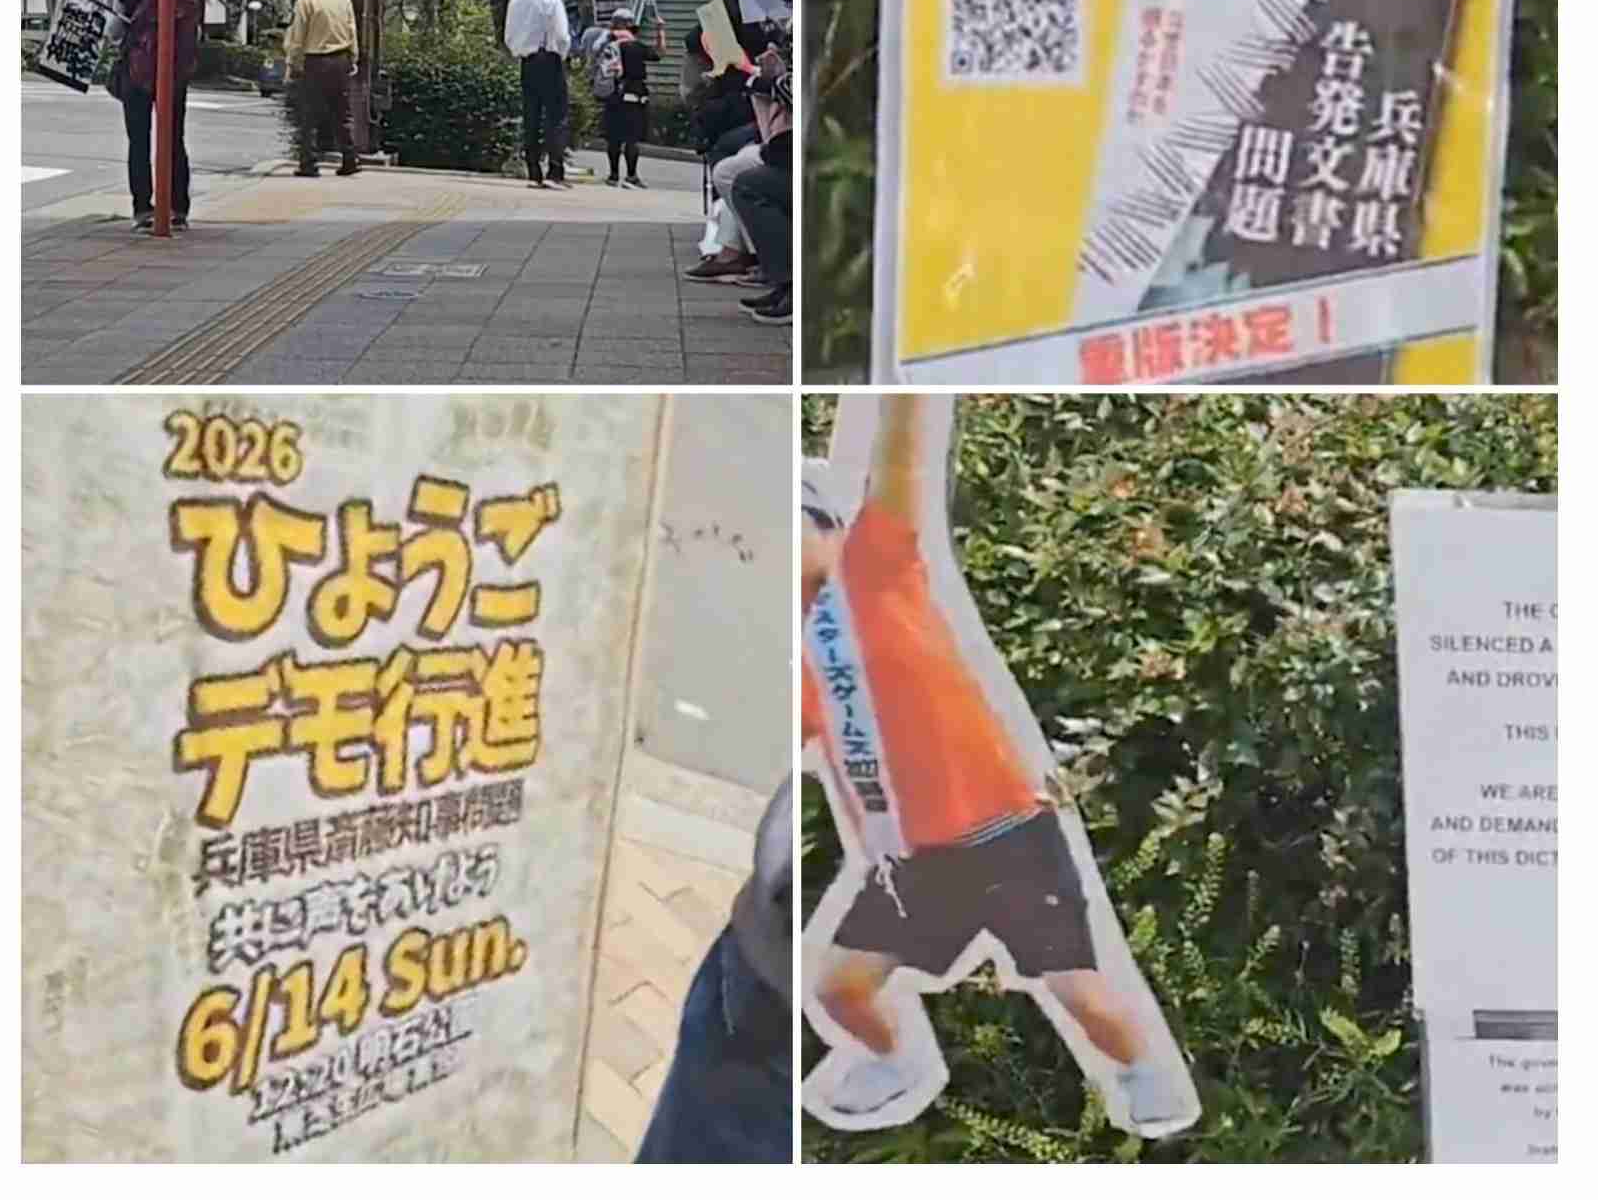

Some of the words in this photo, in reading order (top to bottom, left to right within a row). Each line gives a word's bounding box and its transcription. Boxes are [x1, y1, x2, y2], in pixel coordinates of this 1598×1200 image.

[1292, 20, 1375, 251] 告発文書
[1222, 123, 1294, 244] 問題
[163, 409, 303, 488] 2026
[168, 474, 561, 650] ひょうご
[1503, 601, 1545, 619] THE
[1429, 633, 1535, 653] SILENCED
[1446, 668, 1491, 687] AND
[1496, 670, 1558, 688] DROV
[173, 638, 545, 829] デモ行進
[1505, 723, 1550, 742] THIS
[1480, 783, 1511, 800] WE
[1430, 814, 1474, 832] AND
[1431, 848, 1457, 866] OF
[1465, 849, 1510, 866] THIS
[175, 942, 372, 1098] 6/14
[376, 913, 529, 1018] Sun.
